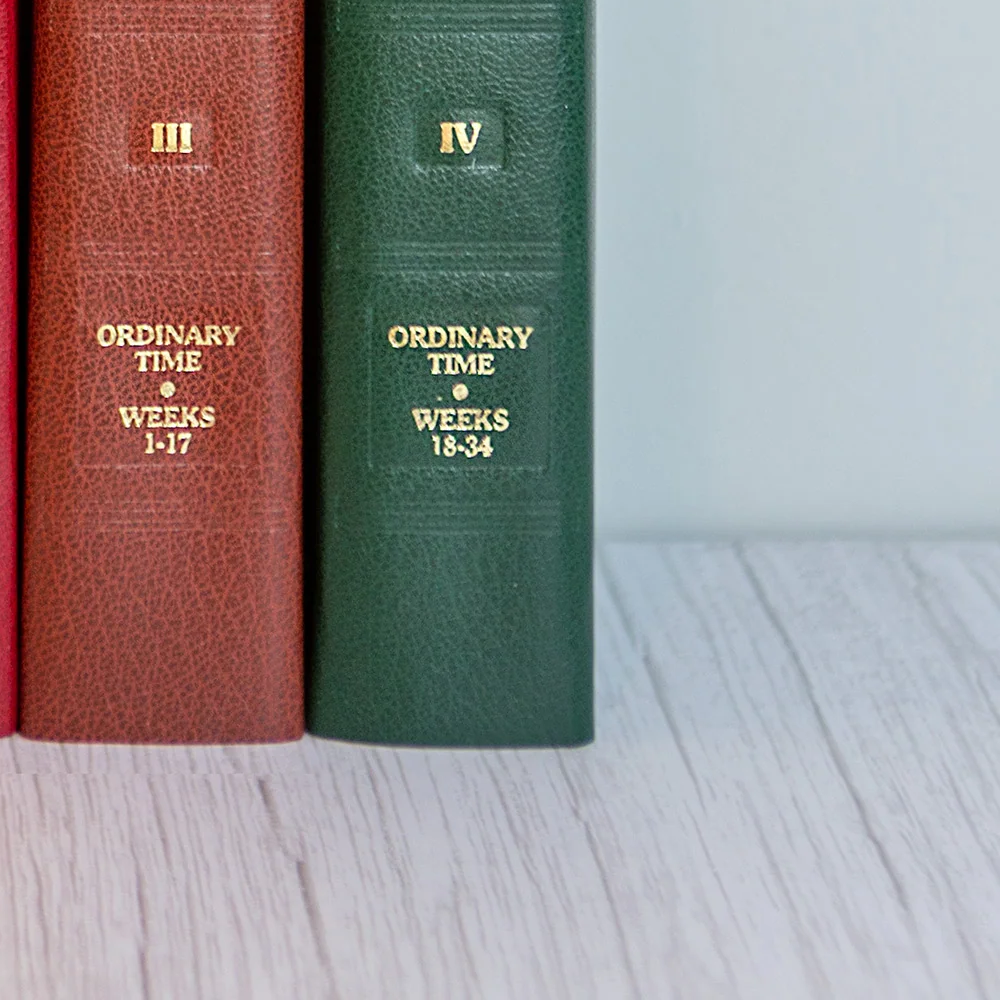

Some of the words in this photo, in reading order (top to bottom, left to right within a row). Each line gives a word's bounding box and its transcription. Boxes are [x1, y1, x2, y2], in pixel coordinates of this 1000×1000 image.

[150, 121, 194, 155] III
[439, 121, 482, 156] IV
[95, 323, 241, 348] ORDINARY
[388, 325, 534, 350] ORDINARY
[133, 350, 202, 373] TIME
[426, 352, 496, 376] TIME
[118, 405, 216, 429] WEEKS
[411, 407, 510, 432] WEEKS
[144, 431, 192, 455] 1-17
[431, 433, 494, 458] 18-34
